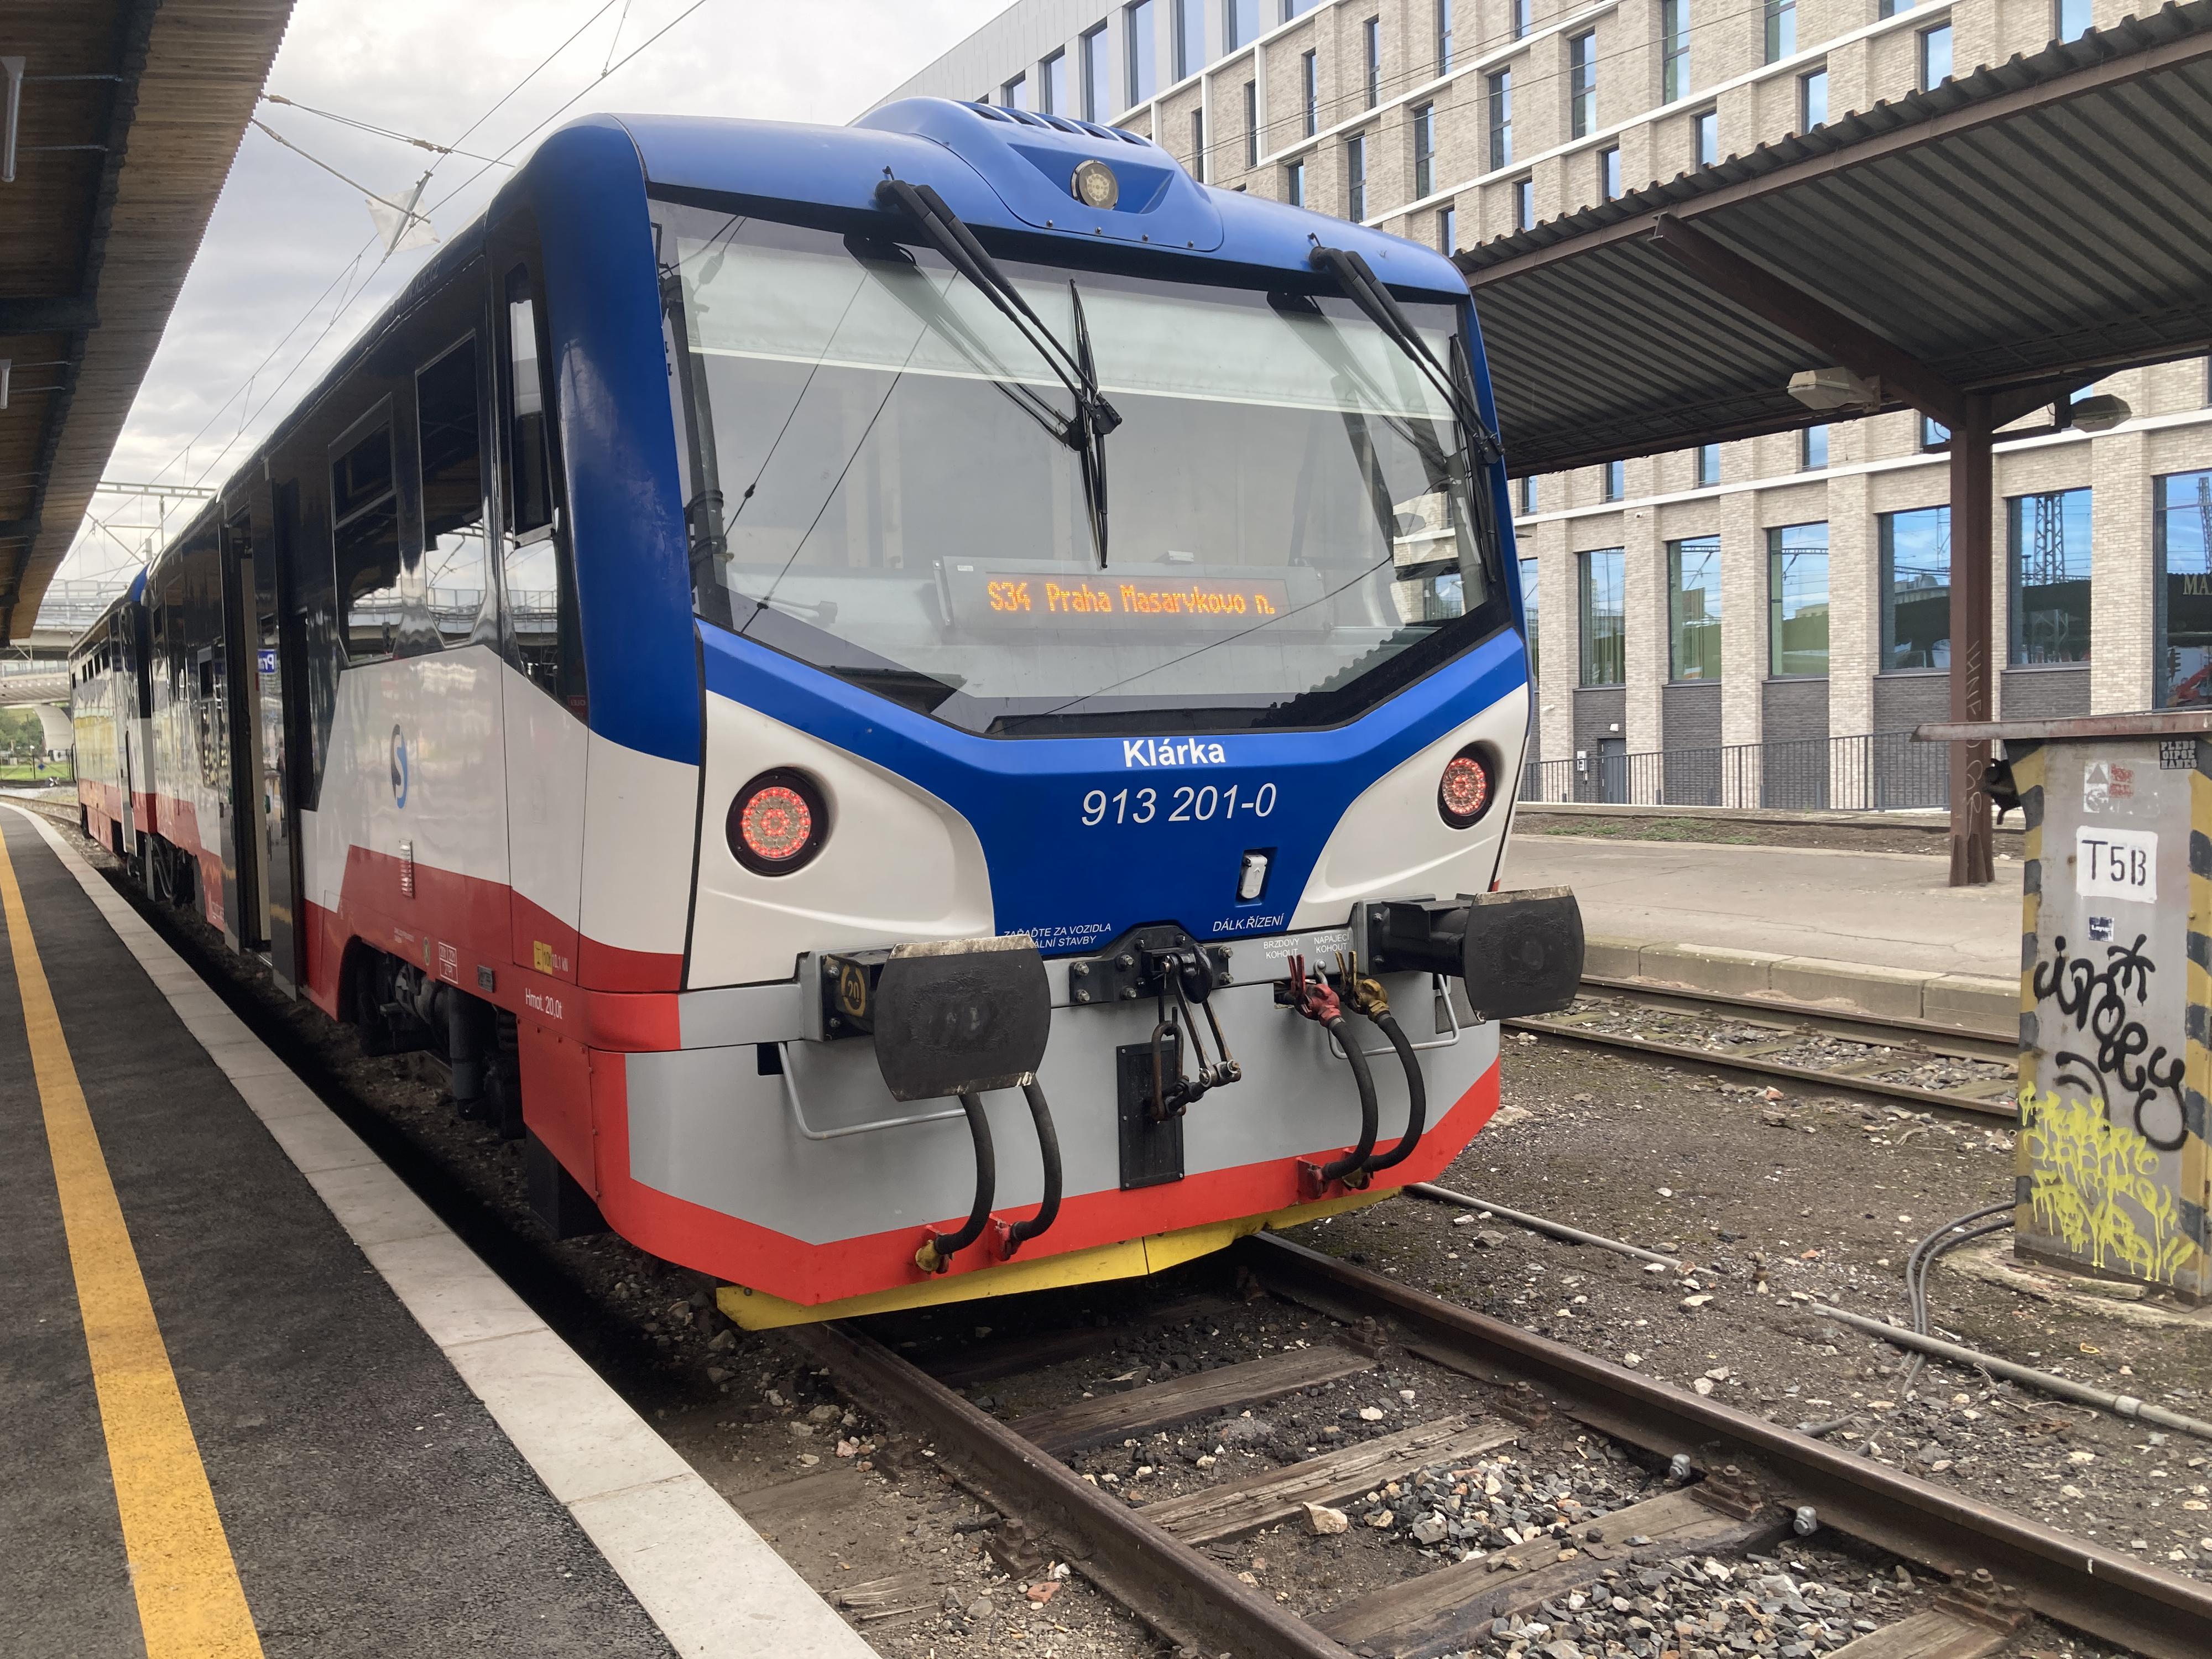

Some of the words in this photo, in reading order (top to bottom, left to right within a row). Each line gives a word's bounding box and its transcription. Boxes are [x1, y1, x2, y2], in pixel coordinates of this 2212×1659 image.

[988, 582, 1031, 611] S34
[1046, 583, 1112, 612] Praha
[1255, 594, 1275, 614] n.
[1123, 738, 1225, 768] Klárka
[1082, 789, 1156, 825] 913
[1168, 783, 1276, 822] 201-0
[1053, 927, 1067, 936] ZA
[1070, 923, 1112, 935] VOZIDLA
[1266, 948, 1298, 959] KOHOUT
[1316, 943, 1348, 953] KOHOUT
